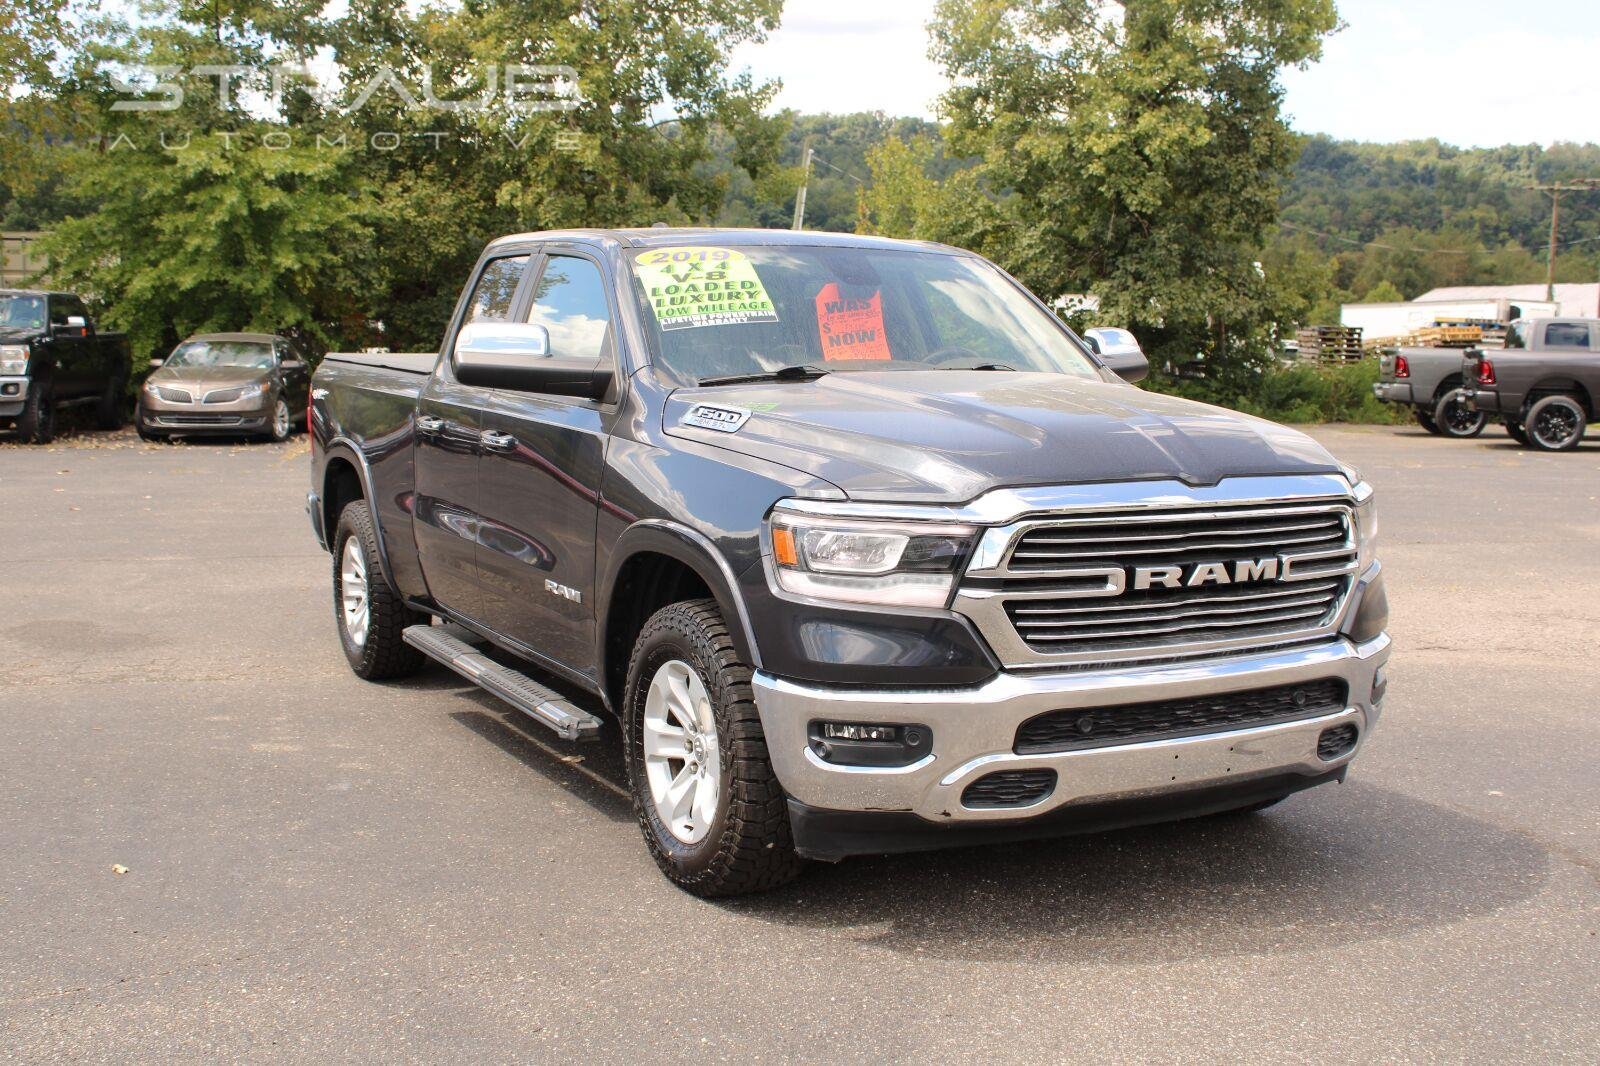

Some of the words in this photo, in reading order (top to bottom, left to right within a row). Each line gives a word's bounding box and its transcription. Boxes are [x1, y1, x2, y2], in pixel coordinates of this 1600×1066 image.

[650, 251, 731, 264] 2019
[672, 271, 726, 283] V-8
[651, 280, 757, 297] LOADED
[656, 290, 761, 308] LUXURY
[824, 300, 872, 314] WAS
[657, 306, 690, 318] LOW
[697, 301, 769, 314] MILEAGE
[828, 329, 876, 348] NOW
[697, 406, 741, 424] 1500
[1133, 556, 1278, 590] RAM
[544, 578, 582, 604] RAM
